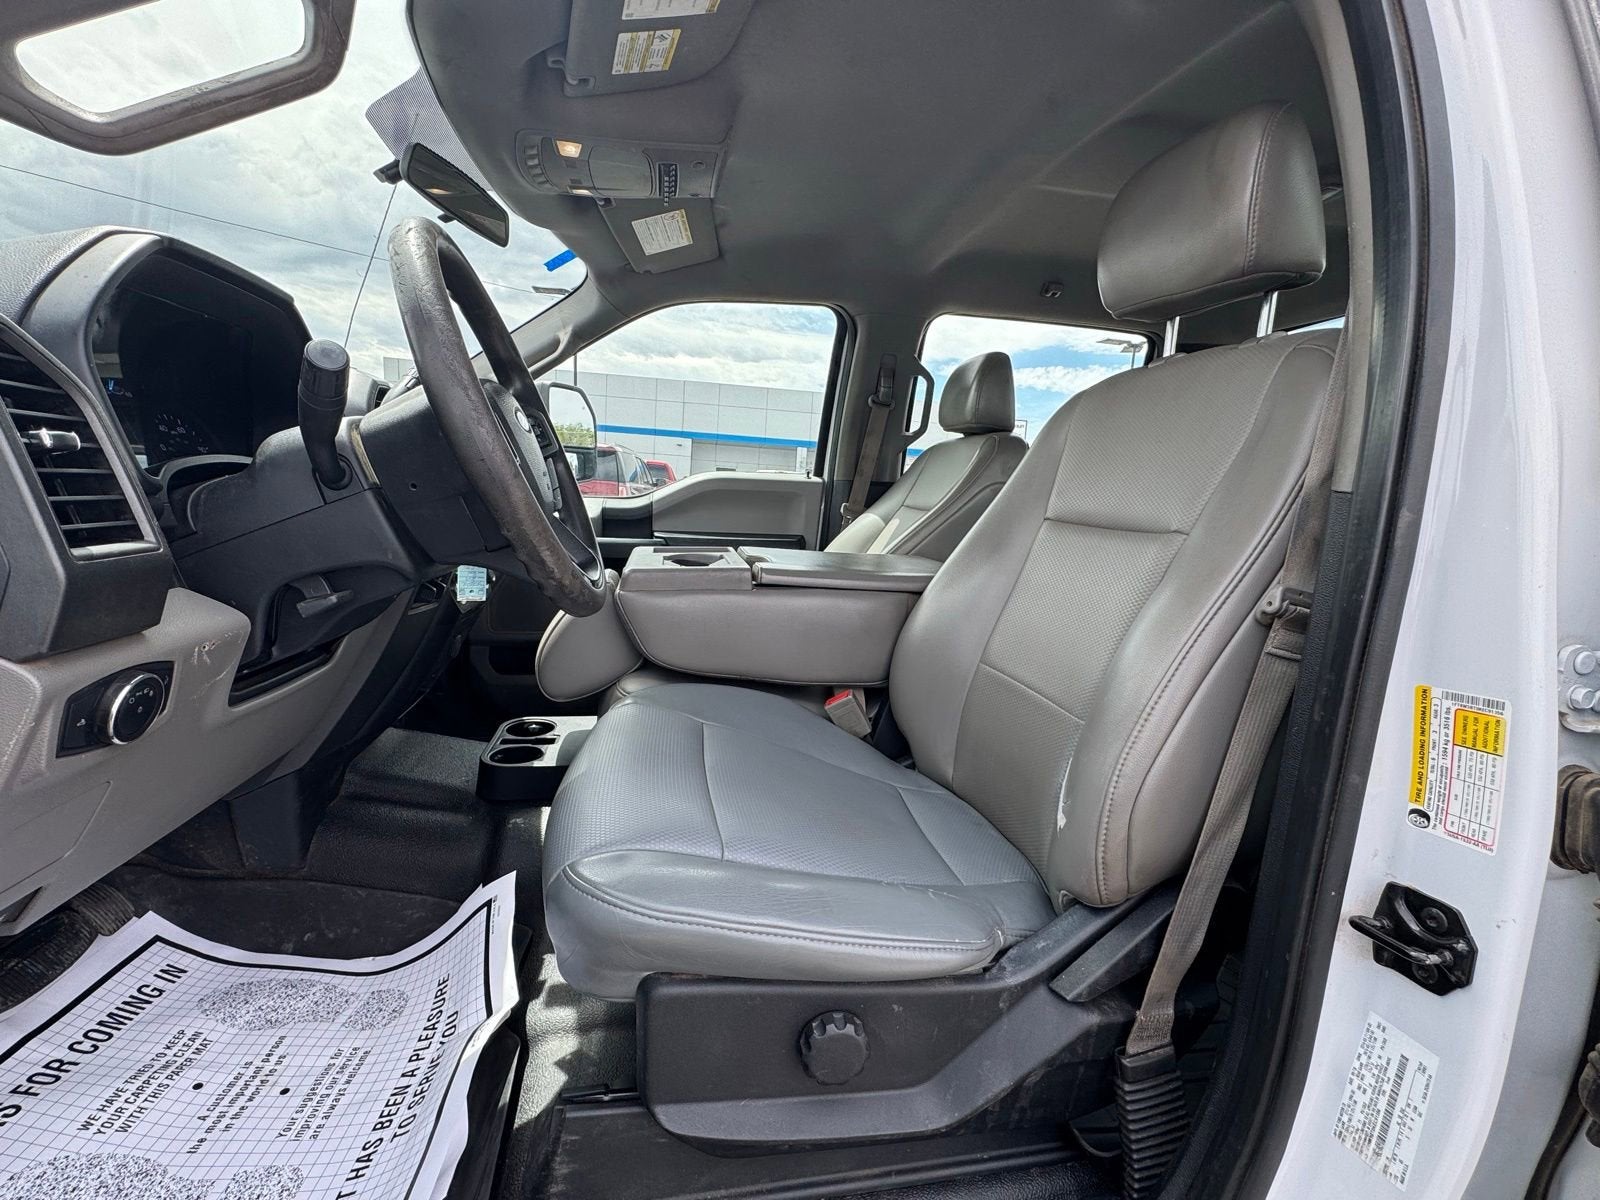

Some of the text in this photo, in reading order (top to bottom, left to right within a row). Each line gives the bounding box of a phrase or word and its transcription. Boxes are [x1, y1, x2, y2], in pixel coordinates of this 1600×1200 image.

[1420, 688, 1428, 737] INFORMATION
[1493, 719, 1501, 753] INFORMATION
[8, 1058, 80, 1097] FOR
[67, 984, 166, 1054] COMING
[153, 963, 189, 984] IN
[408, 972, 450, 1064] PLEASURE
[76, 1030, 187, 1132] WE HAVE TRIED TO KEEP
[93, 1031, 204, 1136] YOUR CARPETING CLEAN
[115, 1038, 214, 1134] WITH THIS PAPER MAT
[186, 1035, 288, 1154] the most important person
[206, 1072, 245, 1112] customer
[240, 1060, 254, 1070] is
[220, 1123, 235, 1132] in
[230, 1105, 248, 1120] the
[245, 1079, 270, 1104] world
[264, 1068, 278, 1077] to
[275, 1048, 344, 1139] Your suggestions for
[290, 1046, 360, 1142] improving our service
[309, 1123, 326, 1140] are
[322, 1088, 347, 1120] always
[372, 1084, 412, 1132] BEEN
[390, 1112, 418, 1144] TO
[408, 1049, 446, 1110] SERVE
[401, 1066, 420, 1078] A
[346, 1136, 384, 1182] HAS
